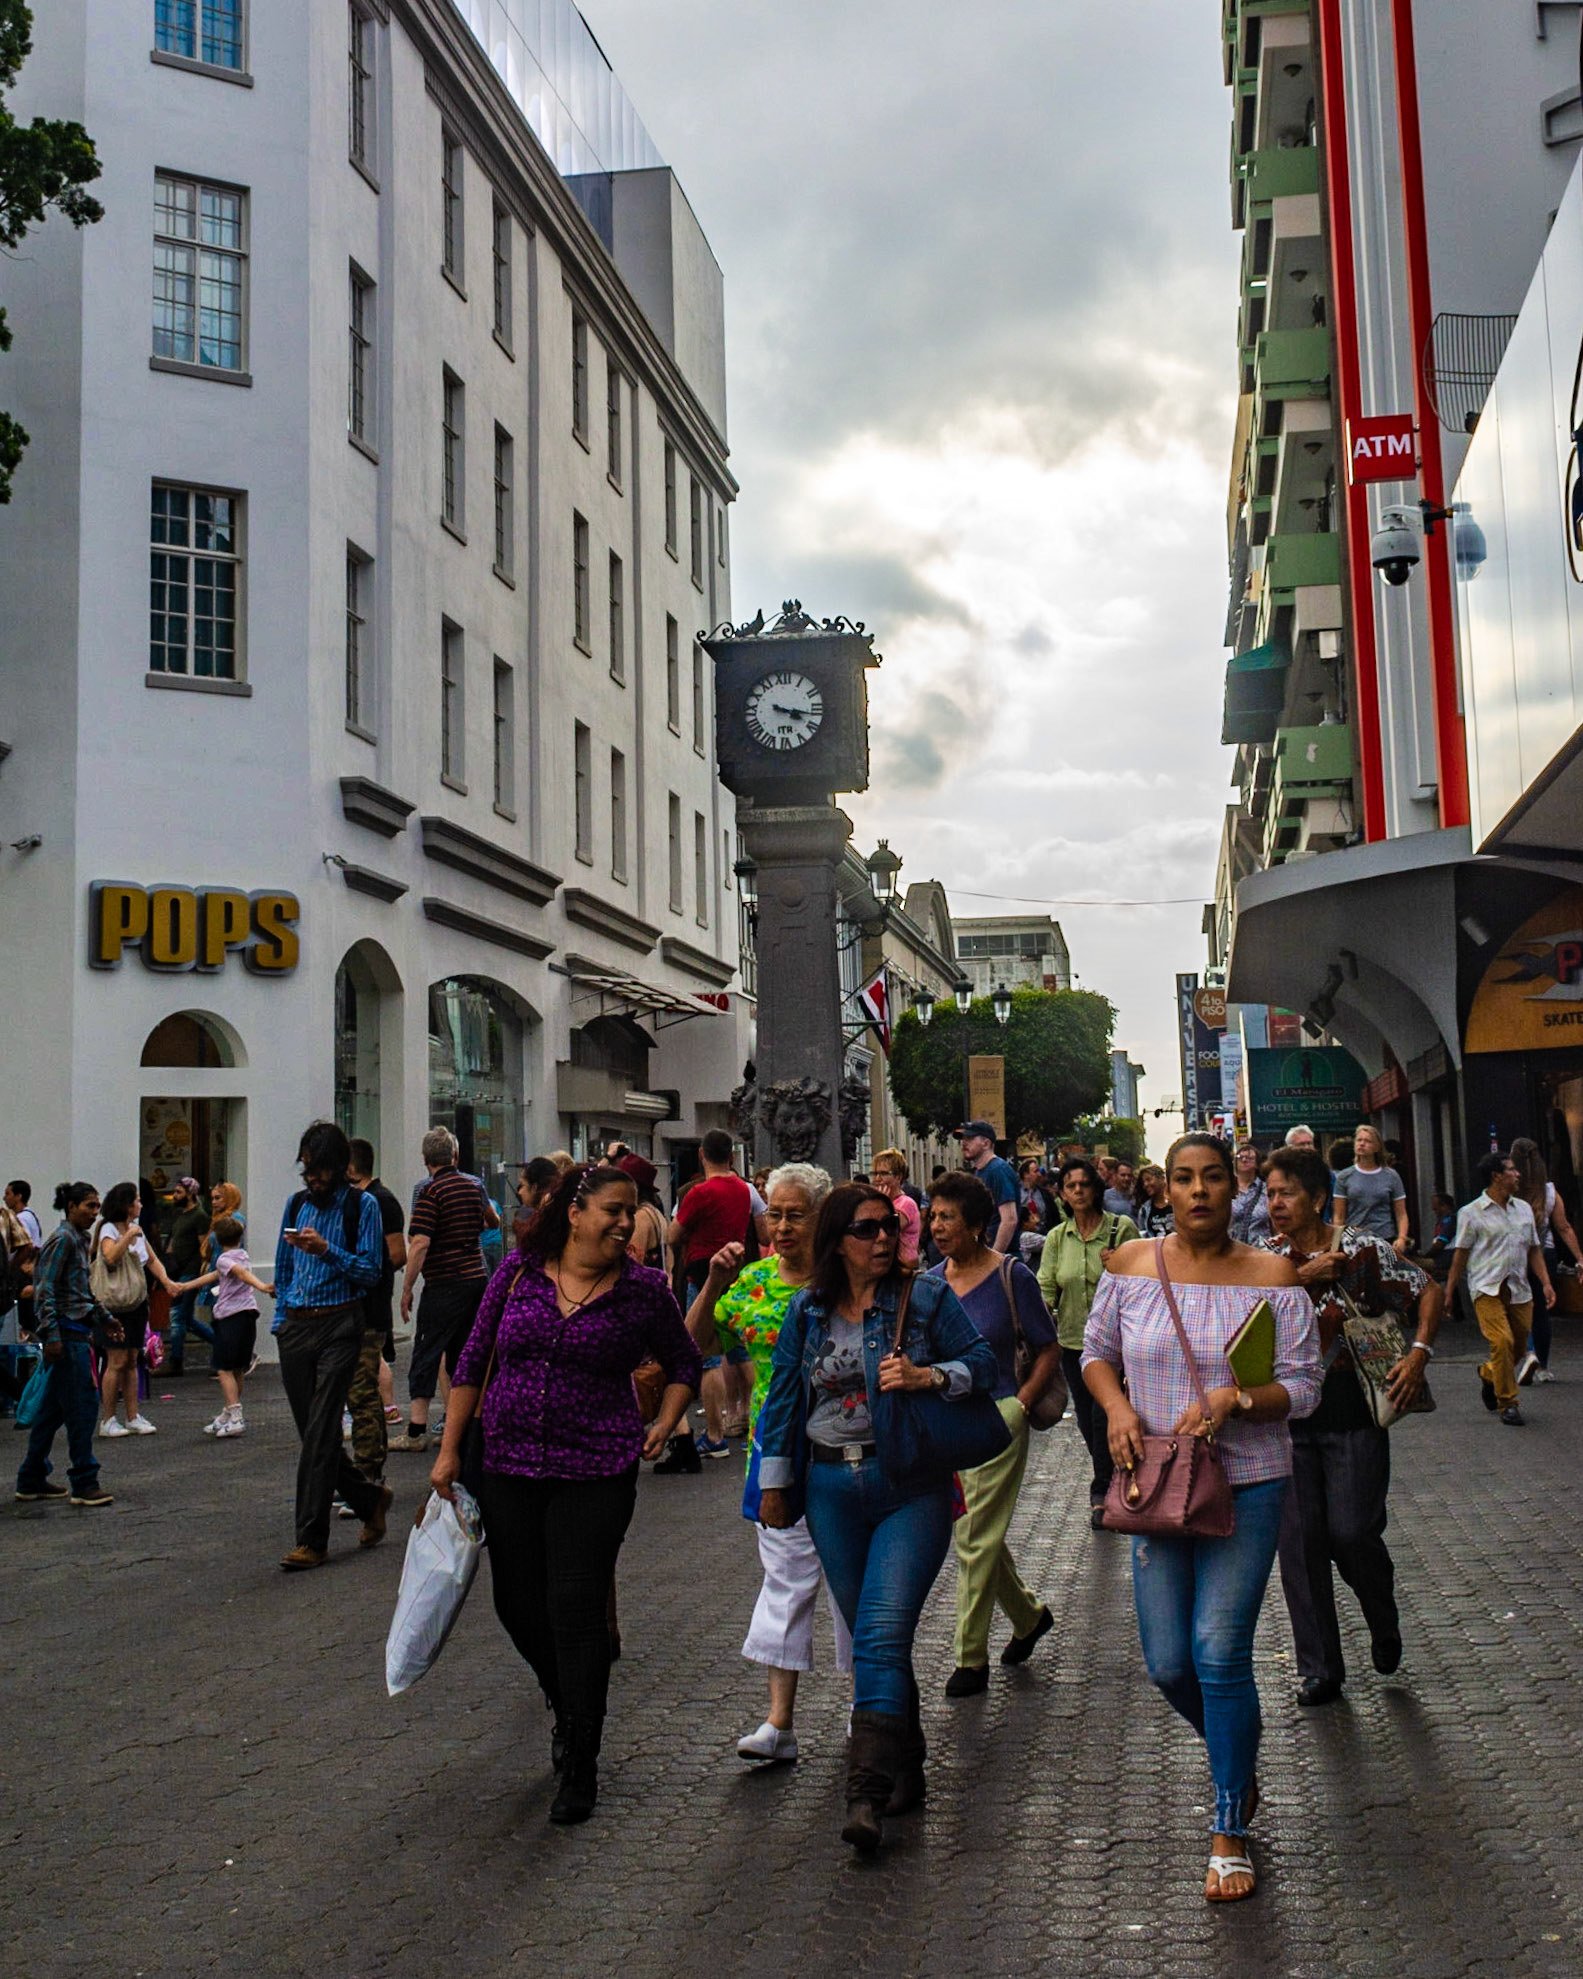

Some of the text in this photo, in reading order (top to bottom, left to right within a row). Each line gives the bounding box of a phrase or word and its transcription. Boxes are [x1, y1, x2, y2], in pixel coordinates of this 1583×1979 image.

[1353, 433, 1411, 458] ATM
[99, 886, 300, 968] POPS
[1201, 1005, 1226, 1016] PISO
[1257, 1101, 1360, 1112] HOTEL & HOSTEL
